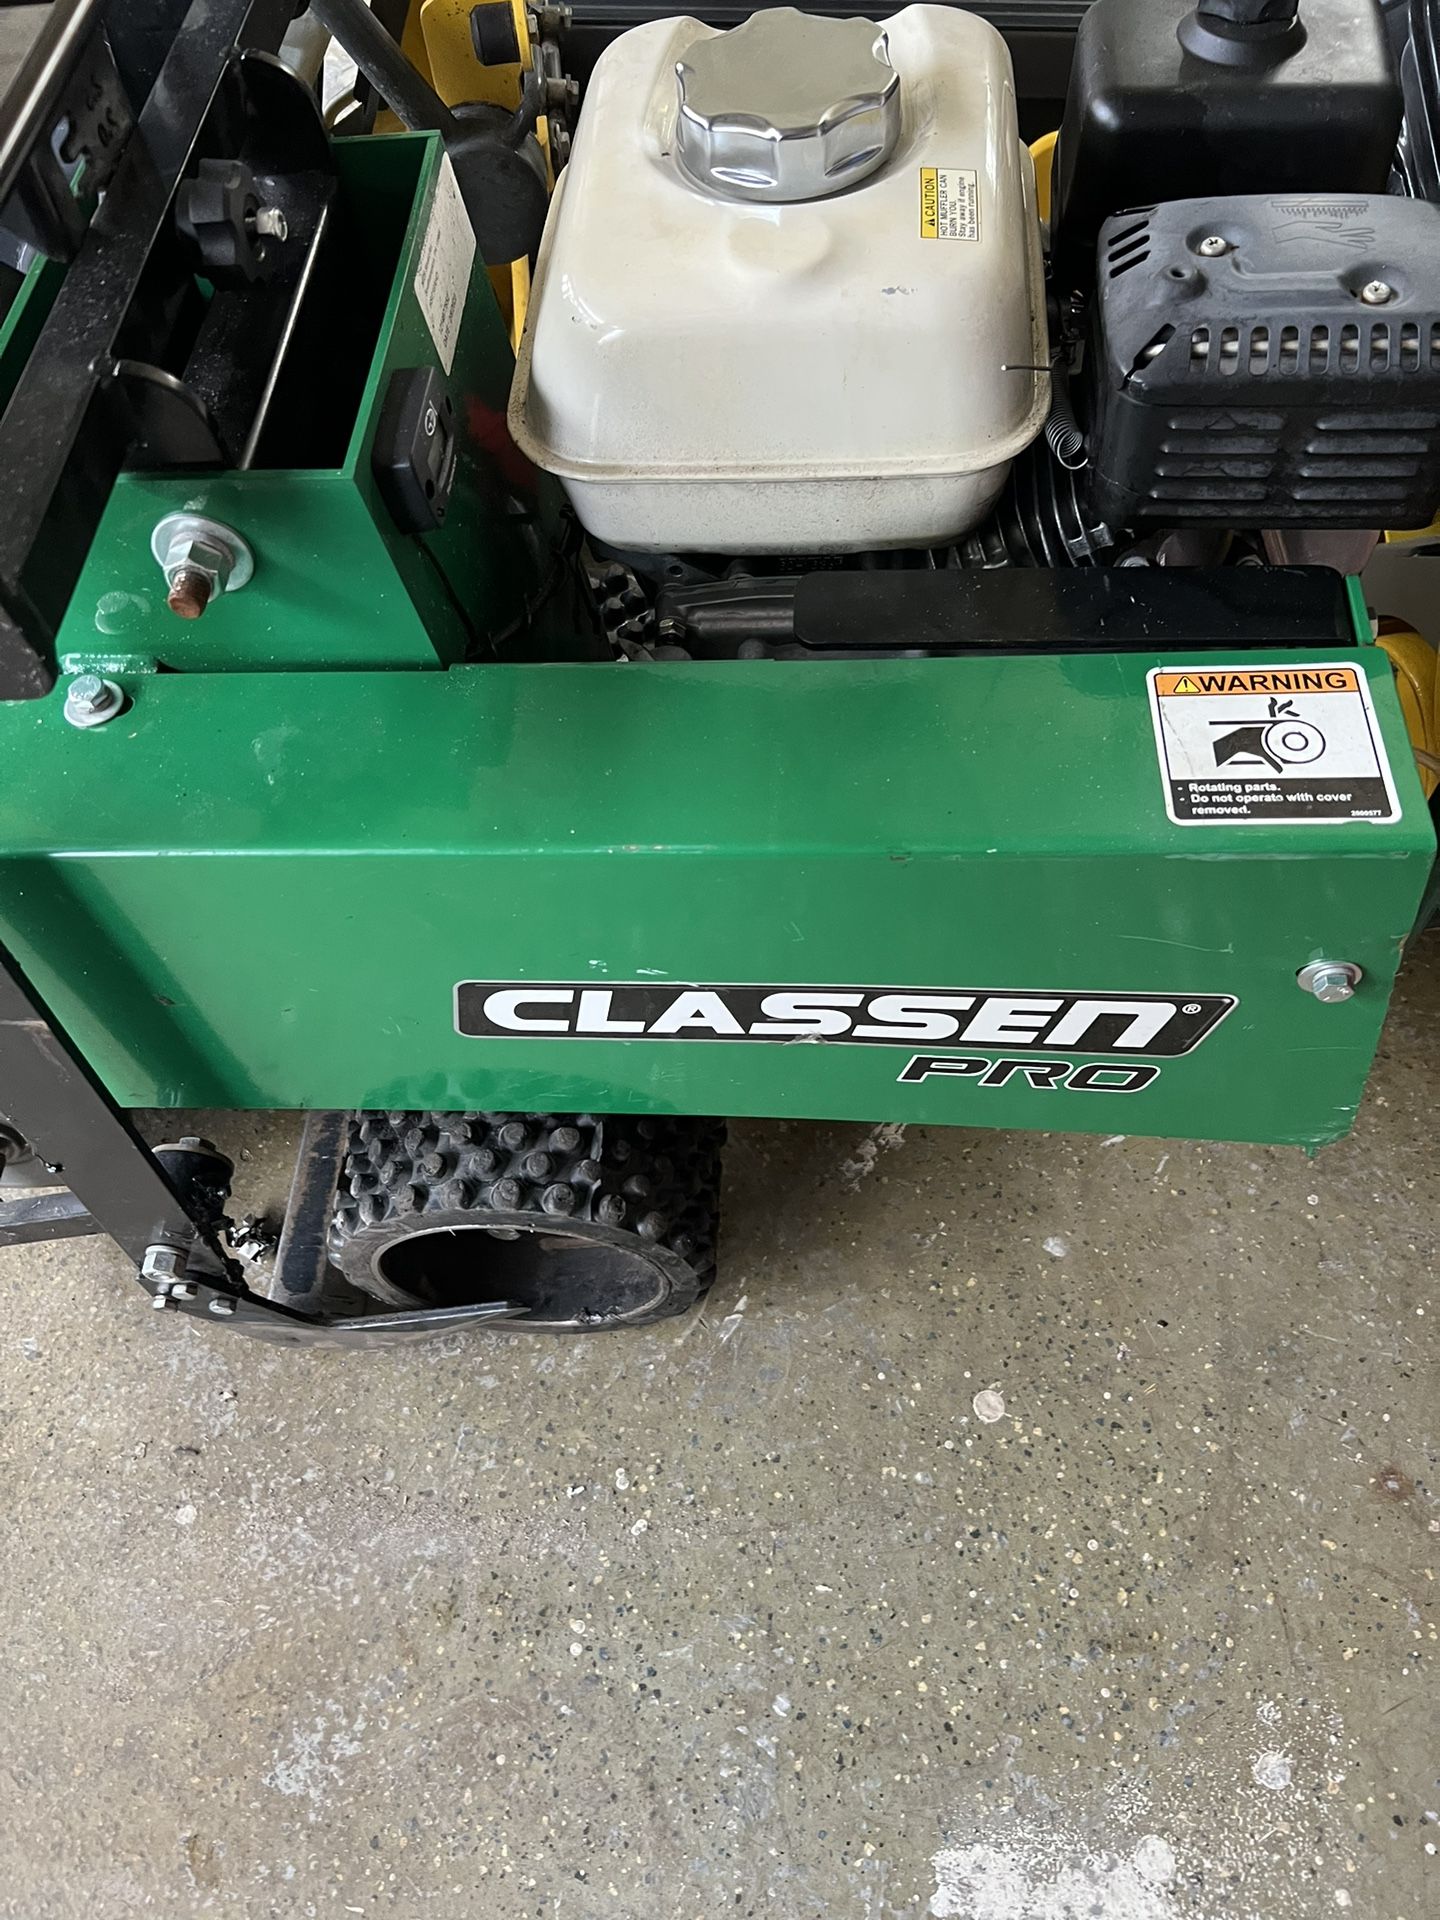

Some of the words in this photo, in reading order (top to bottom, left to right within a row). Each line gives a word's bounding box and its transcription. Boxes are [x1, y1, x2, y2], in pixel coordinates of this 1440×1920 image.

[924, 178, 935, 216] CAUTION
[940, 223, 948, 236] HOT
[949, 218, 957, 236] BURN
[958, 223, 968, 237] Stay
[1199, 672, 1347, 692] WARNING
[1188, 783, 1243, 794] Rotating
[1245, 784, 1281, 794] parts.
[1190, 794, 1210, 803] Do
[1211, 794, 1234, 803] not
[1235, 794, 1284, 804] operate
[1285, 793, 1314, 802] with
[1316, 793, 1353, 802] cover
[1192, 805, 1251, 815] removed.
[896, 1054, 1161, 1093] PRO
